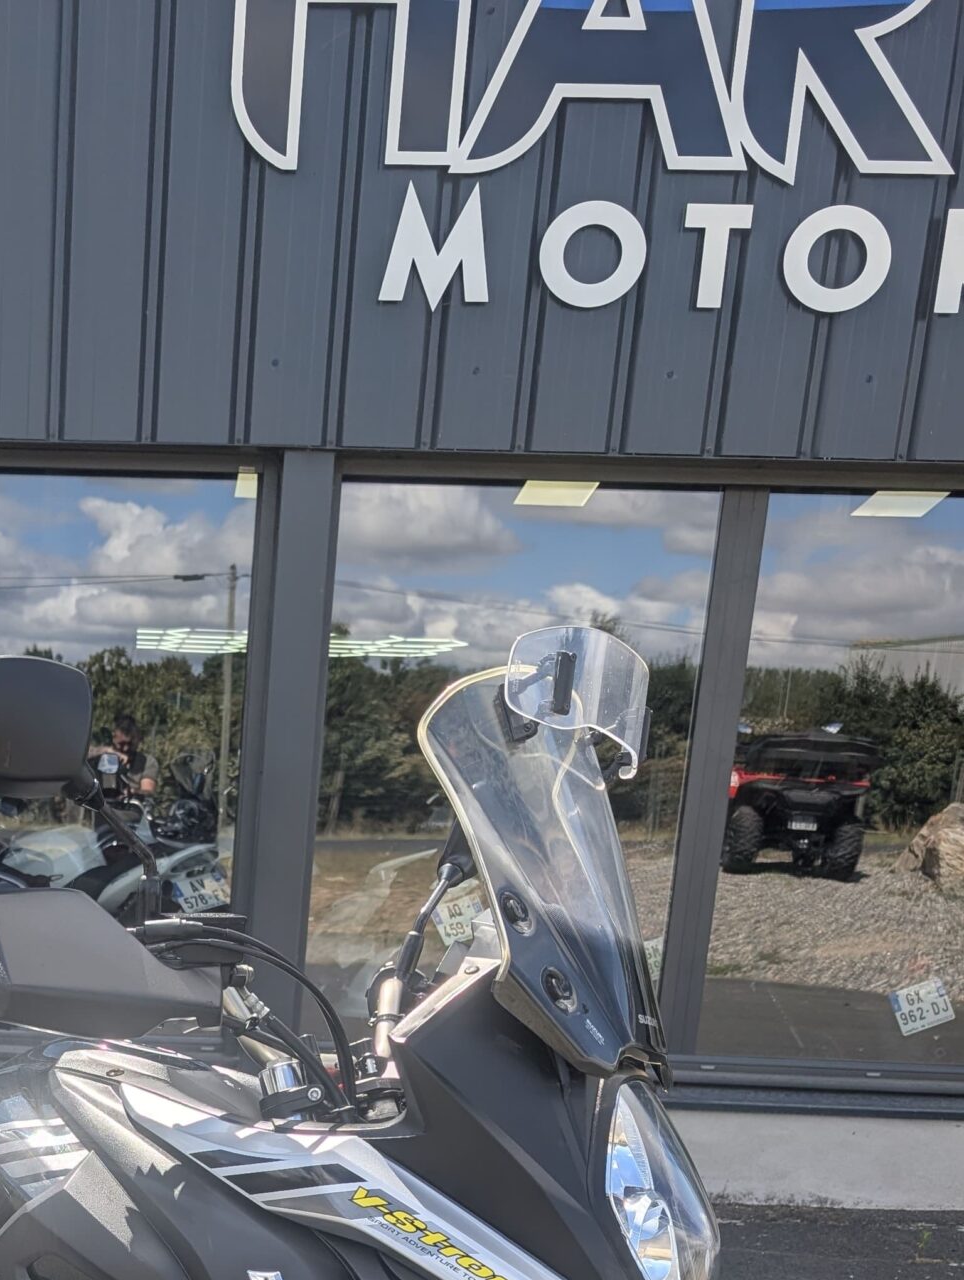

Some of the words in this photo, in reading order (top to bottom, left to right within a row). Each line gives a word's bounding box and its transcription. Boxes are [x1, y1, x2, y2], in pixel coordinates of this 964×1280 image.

[899, 998, 949, 1026] 962-DJ
[367, 1215, 401, 1236] SPORT
[402, 1235, 460, 1274] ADVENTURE
